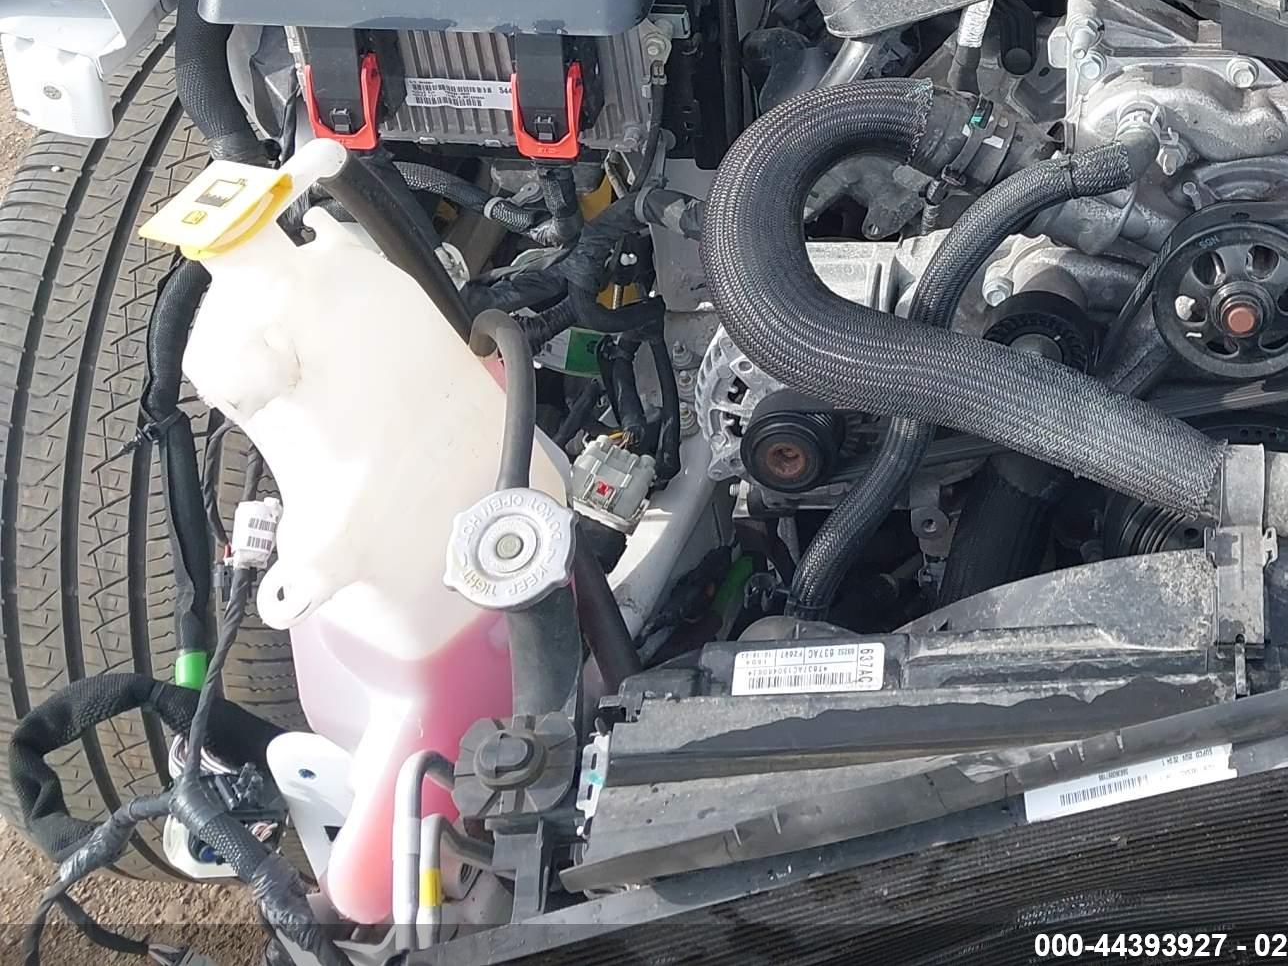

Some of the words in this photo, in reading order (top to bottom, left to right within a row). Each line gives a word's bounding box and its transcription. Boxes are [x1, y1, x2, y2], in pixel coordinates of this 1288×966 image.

[481, 494, 525, 516] OPEN
[463, 568, 498, 597] TIGHT
[507, 562, 549, 596] KEEP
[859, 648, 874, 683] 637AC
